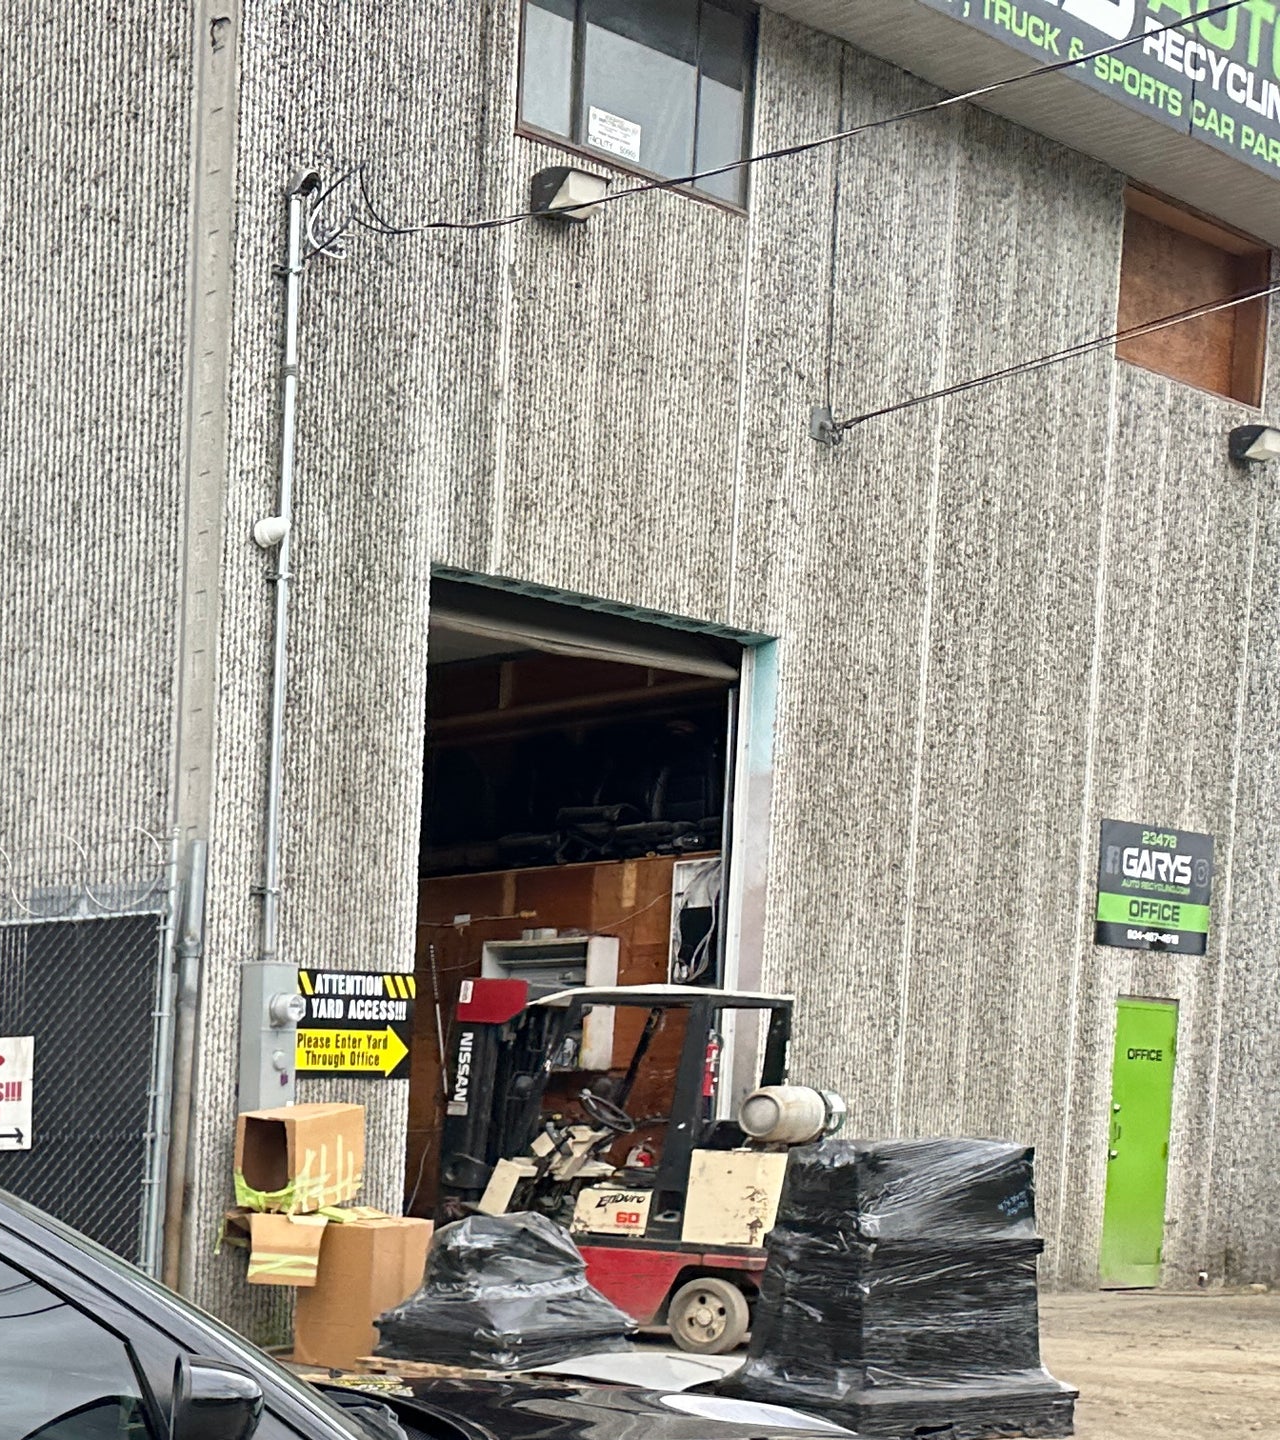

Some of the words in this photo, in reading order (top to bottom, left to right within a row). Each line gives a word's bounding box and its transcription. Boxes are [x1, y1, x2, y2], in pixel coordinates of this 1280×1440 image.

[1147, 0, 1280, 82] AUT
[1068, 36, 1087, 68] &
[1093, 54, 1183, 117] SPORTS
[1193, 99, 1235, 144] CAR
[1142, 831, 1178, 848] 23478
[1123, 847, 1192, 885] GARYS
[1129, 900, 1181, 922] OFFICE
[314, 973, 384, 997] ATTENTION
[311, 998, 344, 1019] YARD
[348, 1000, 407, 1021] ACCESS!!!
[297, 1033, 331, 1049] Please
[335, 1034, 362, 1049] Enter
[367, 1034, 388, 1050] Yard
[305, 1050, 345, 1068] Through
[349, 1051, 380, 1067] Office
[1127, 1048, 1162, 1062] OFFICE
[453, 1032, 474, 1102] NISSAN
[616, 1212, 640, 1223] 60
